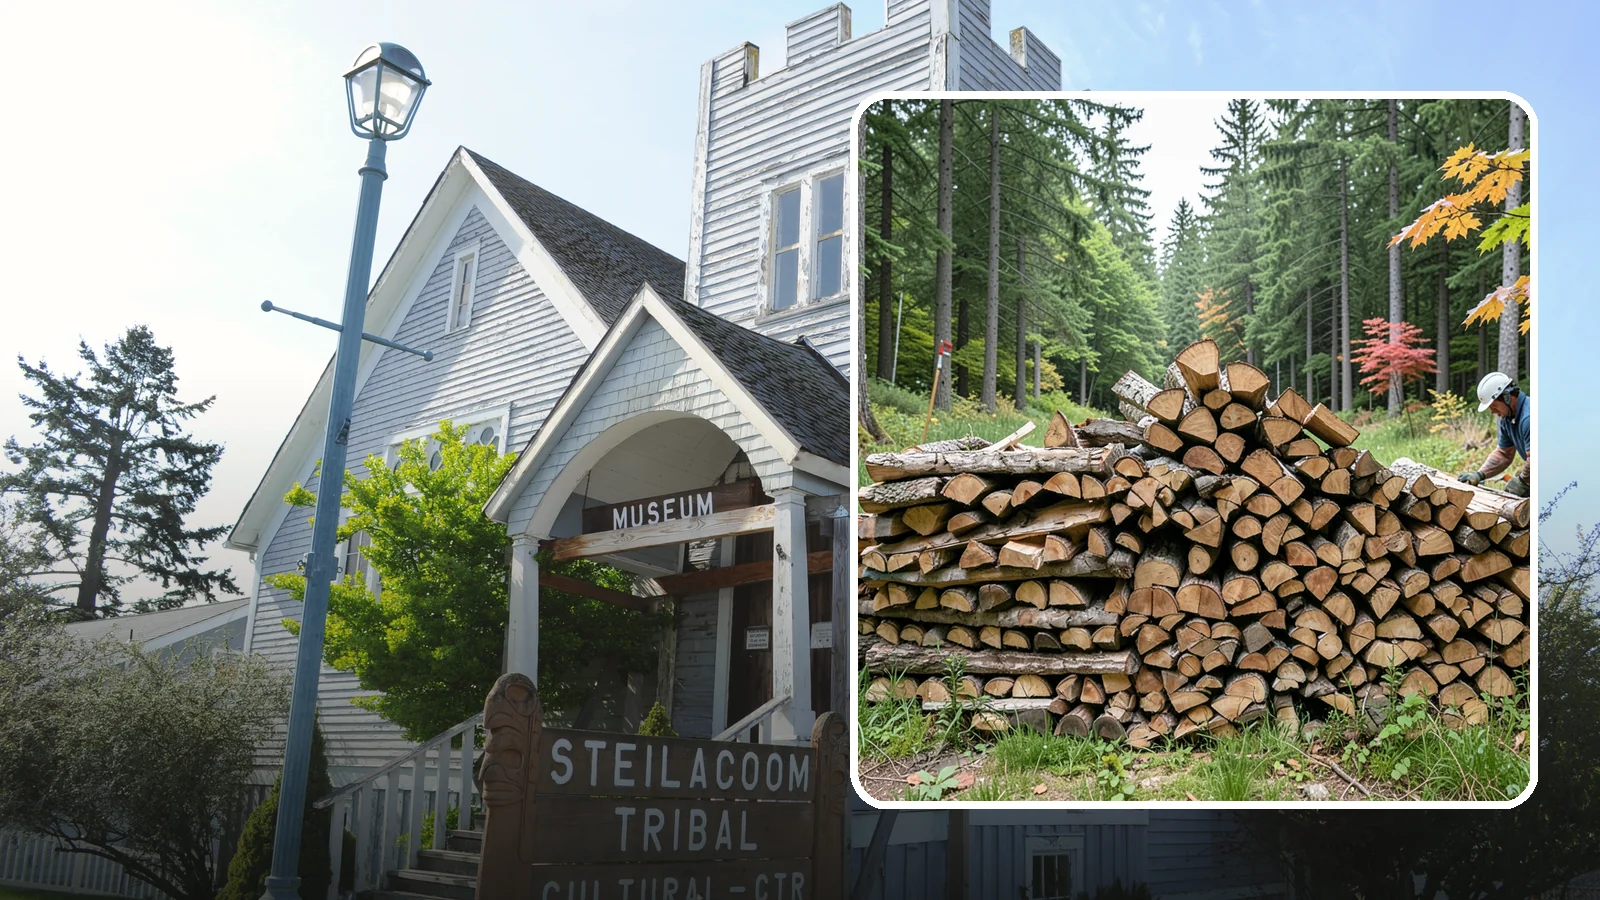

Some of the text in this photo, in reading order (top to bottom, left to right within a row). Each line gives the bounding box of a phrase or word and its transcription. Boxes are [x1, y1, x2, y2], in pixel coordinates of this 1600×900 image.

[612, 491, 714, 531] MUSEUM
[550, 738, 810, 792] STEILACOOM
[615, 806, 758, 852] TRIBAL
